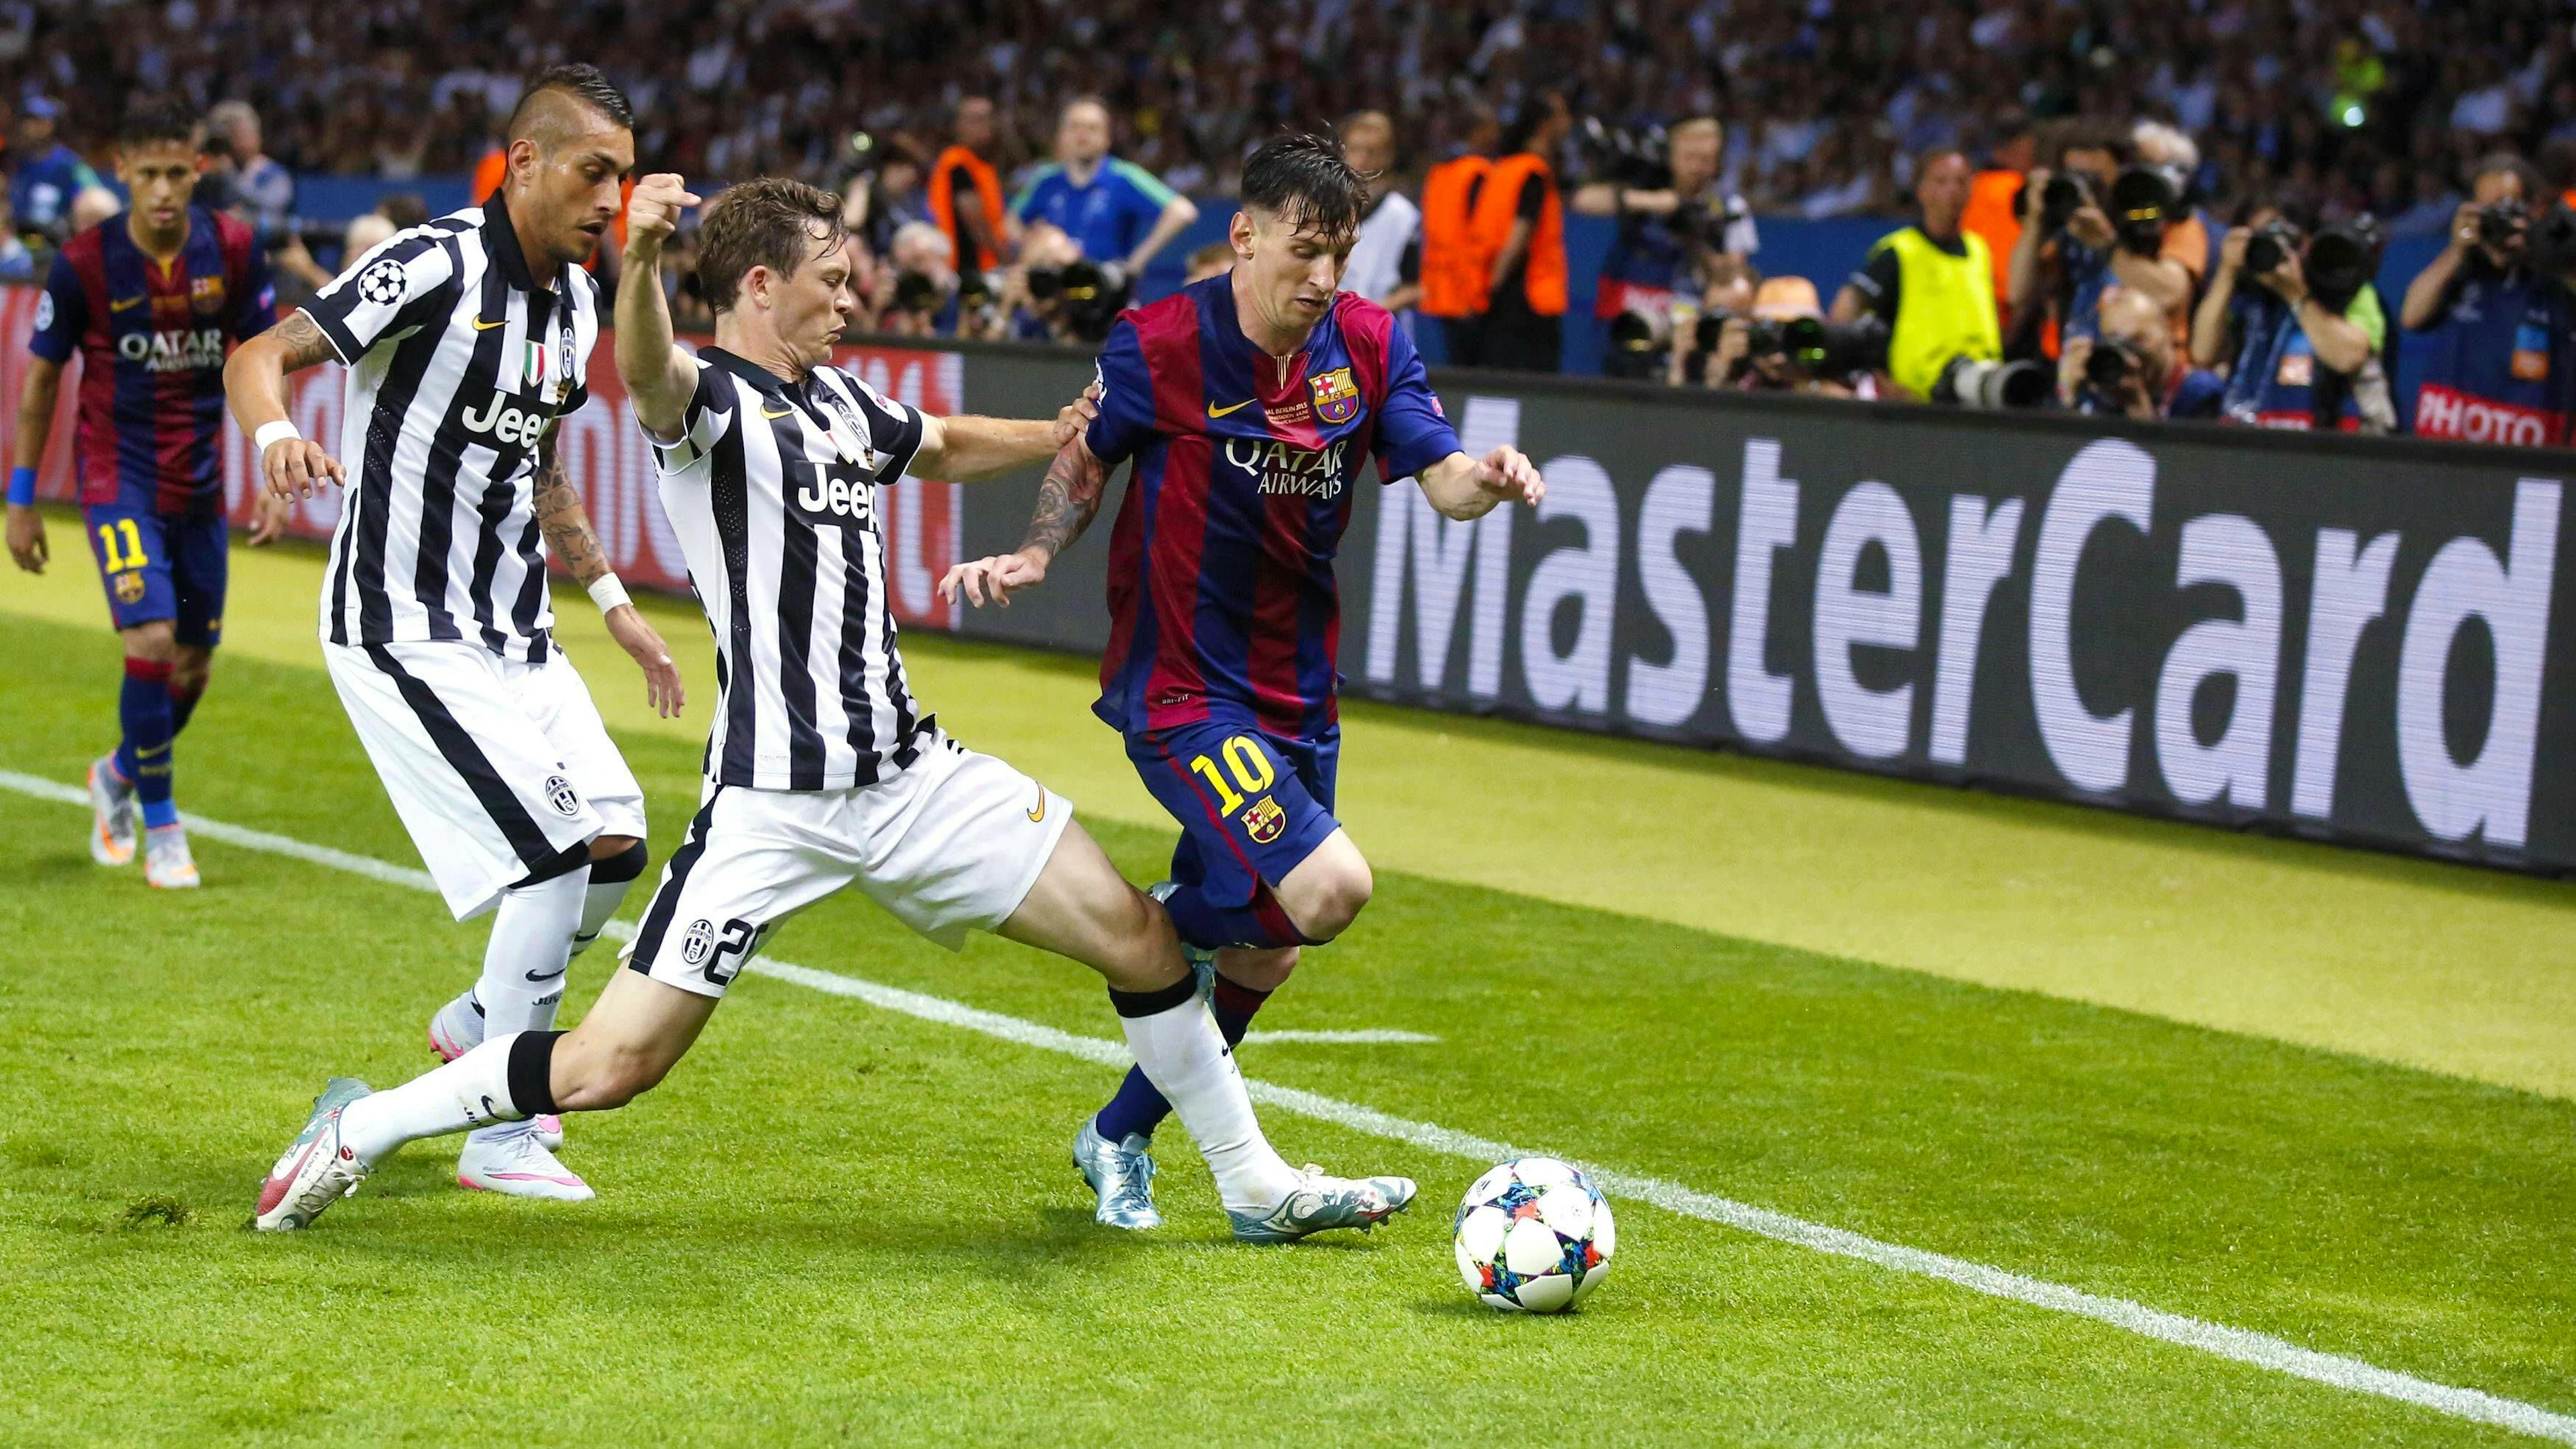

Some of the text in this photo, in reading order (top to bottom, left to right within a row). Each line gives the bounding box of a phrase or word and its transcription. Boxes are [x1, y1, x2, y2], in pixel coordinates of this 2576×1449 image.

[1225, 438, 1348, 478] QATAR
[1257, 472, 1342, 500] AIRWAYS
[99, 516, 149, 574] 11
[1366, 397, 2562, 848] MasterCard
[1190, 735, 1275, 818] 10
[704, 918, 769, 986] 2
